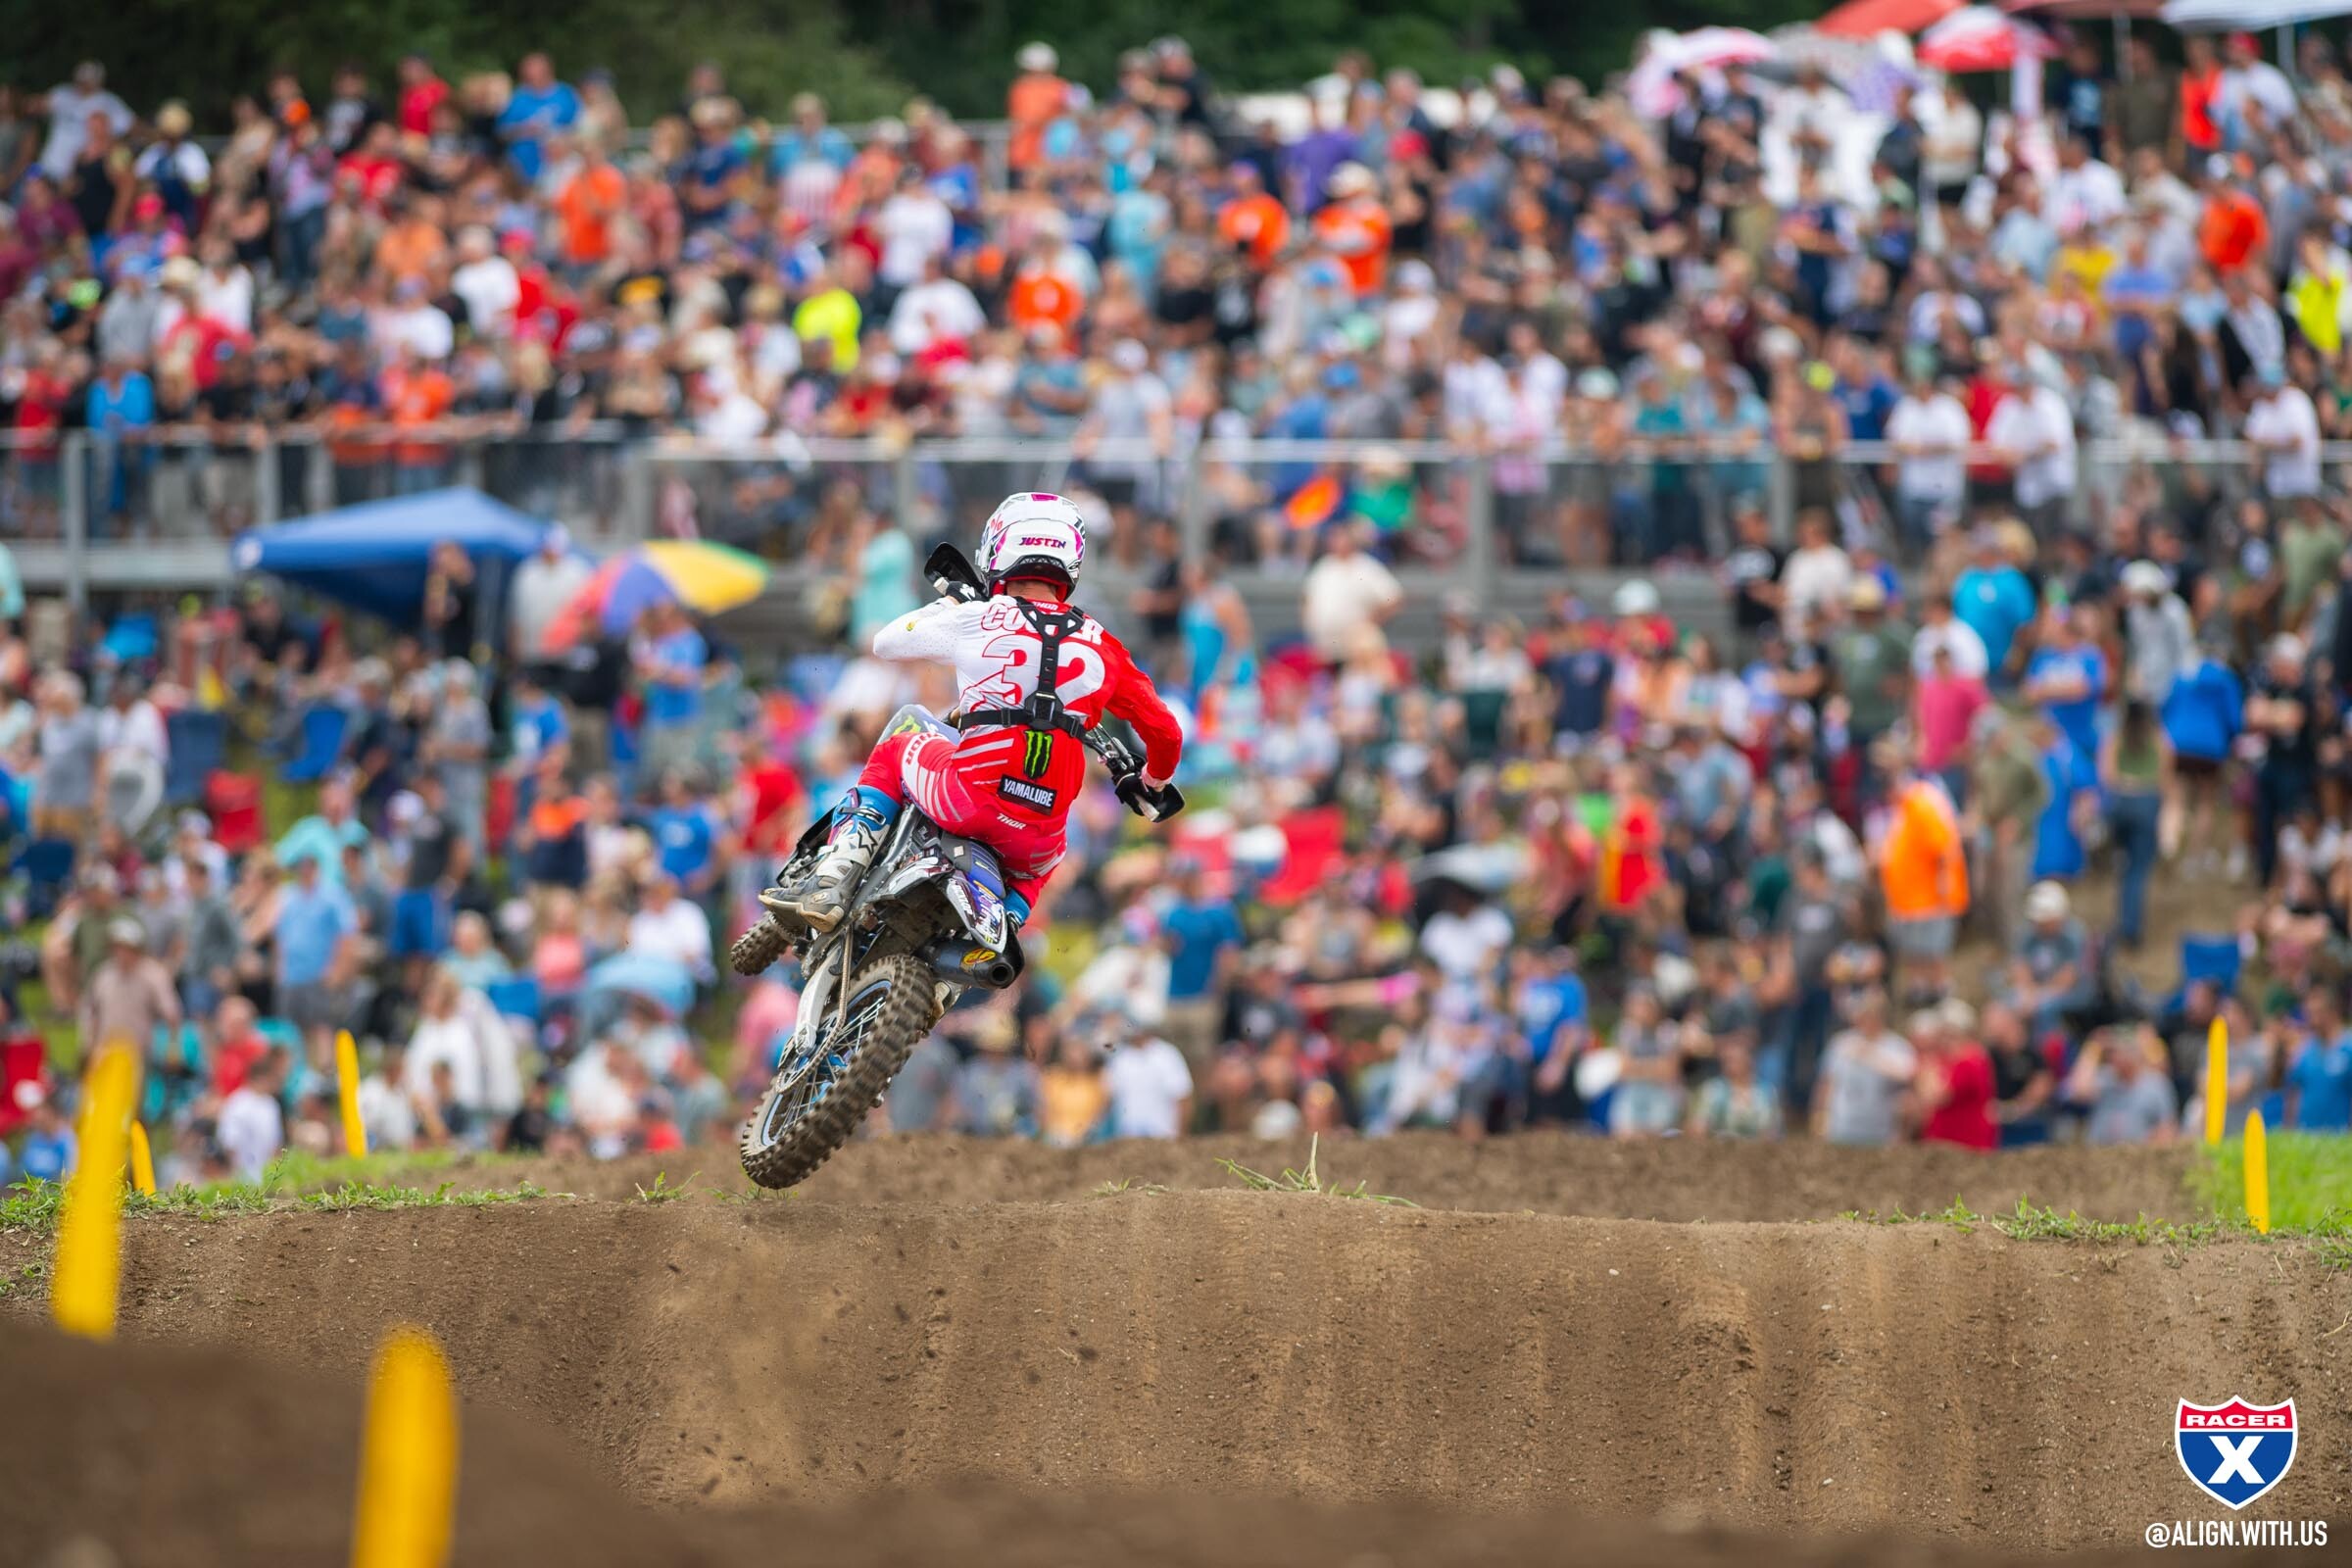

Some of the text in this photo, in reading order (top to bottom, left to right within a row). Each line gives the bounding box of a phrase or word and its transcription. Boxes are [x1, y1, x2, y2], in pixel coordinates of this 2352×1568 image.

[1019, 536, 1067, 550] JUSTIN
[981, 603, 1104, 646] COR
[980, 634, 1106, 716] 32
[1003, 778, 1054, 808] YAMALUBE
[997, 812, 1027, 830] THOR
